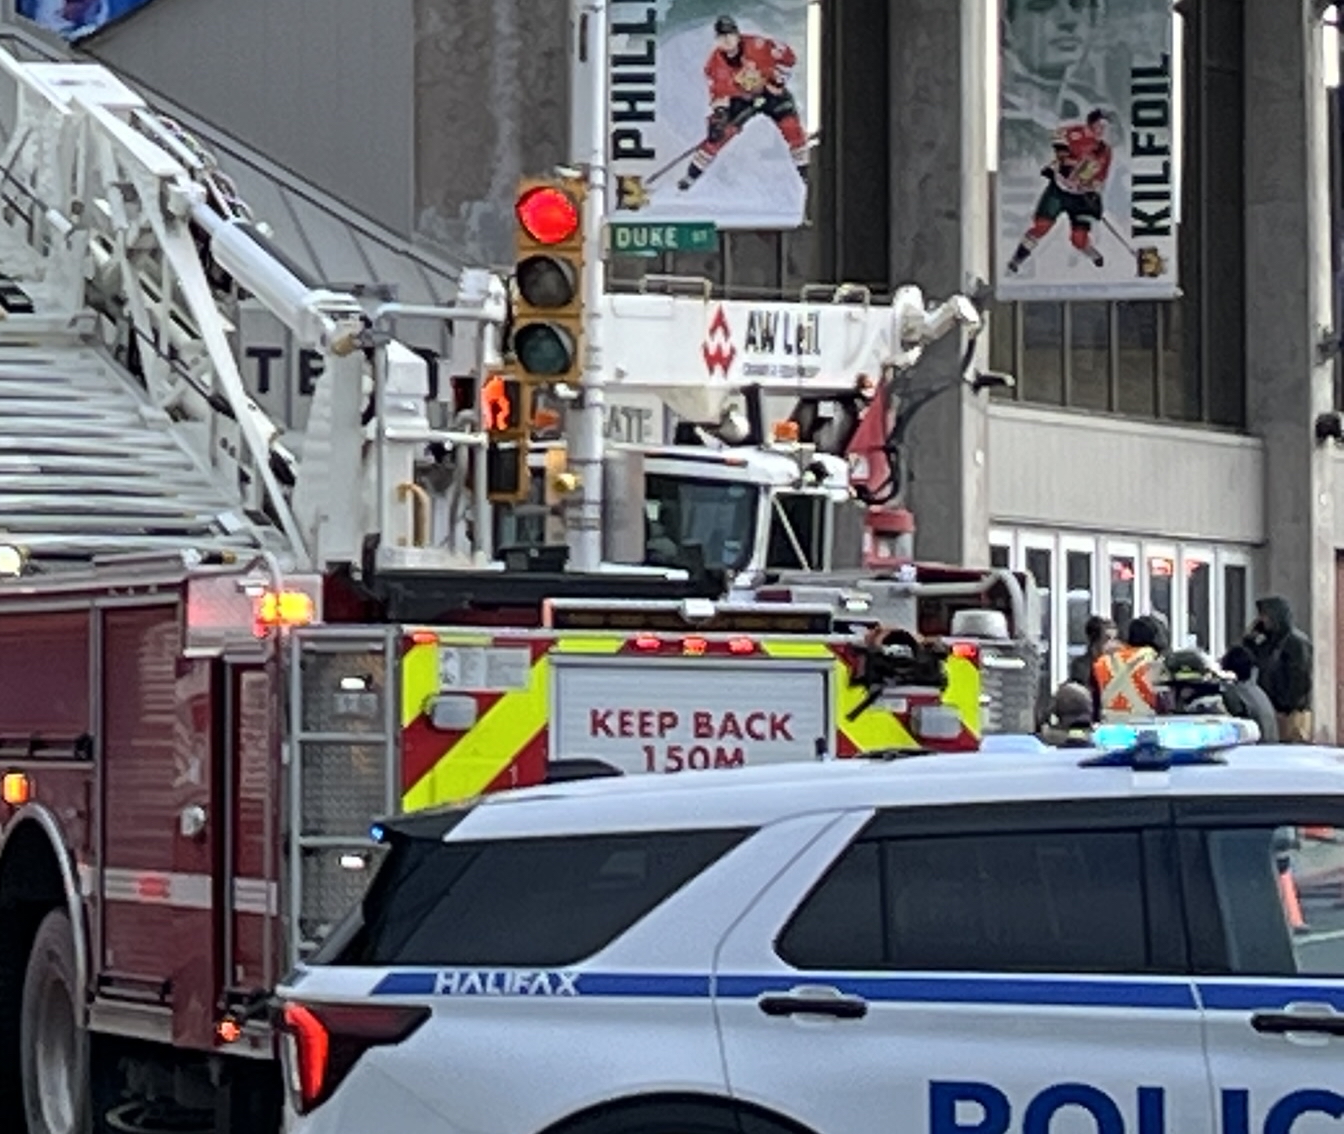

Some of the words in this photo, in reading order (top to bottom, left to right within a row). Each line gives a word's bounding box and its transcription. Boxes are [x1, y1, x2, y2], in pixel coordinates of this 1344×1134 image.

[1130, 51, 1172, 238] KILFOIL
[615, 226, 678, 248] DUKE
[589, 708, 679, 738] KEEP
[693, 711, 795, 741] BACK
[642, 744, 746, 774] 150M
[433, 970, 582, 996] HALIFAX
